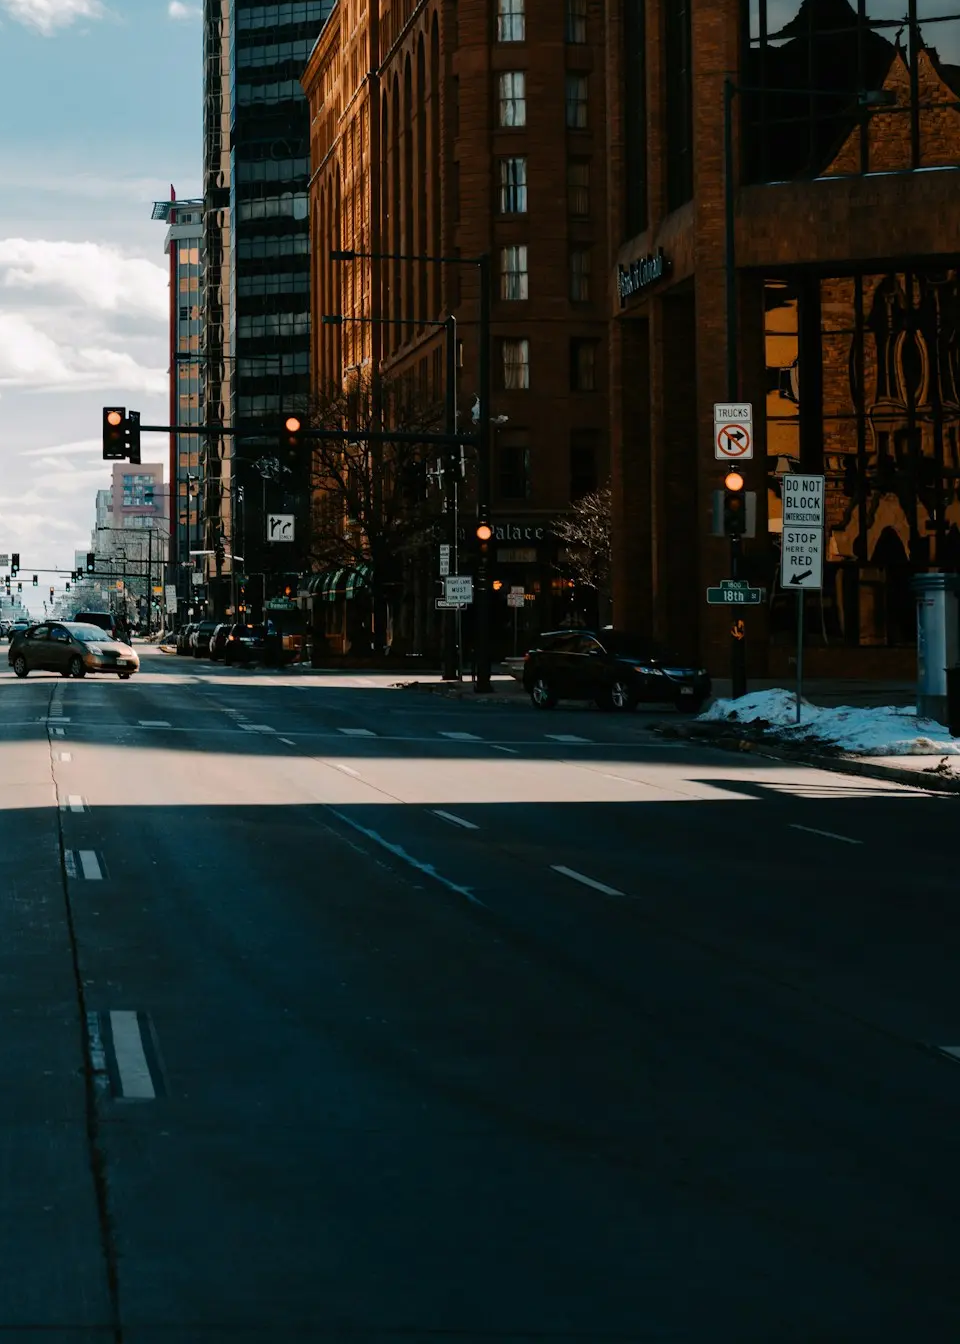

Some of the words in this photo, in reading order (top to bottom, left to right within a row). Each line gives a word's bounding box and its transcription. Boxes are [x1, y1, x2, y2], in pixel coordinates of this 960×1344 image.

[718, 408, 749, 418] TRUCKS
[786, 480, 799, 491] DO
[802, 480, 821, 492] NOT
[786, 496, 821, 509] BLOCK
[785, 512, 820, 522] INTERSECTION
[787, 533, 817, 543] STOP
[790, 555, 813, 566] RED
[723, 590, 744, 602] 18th
